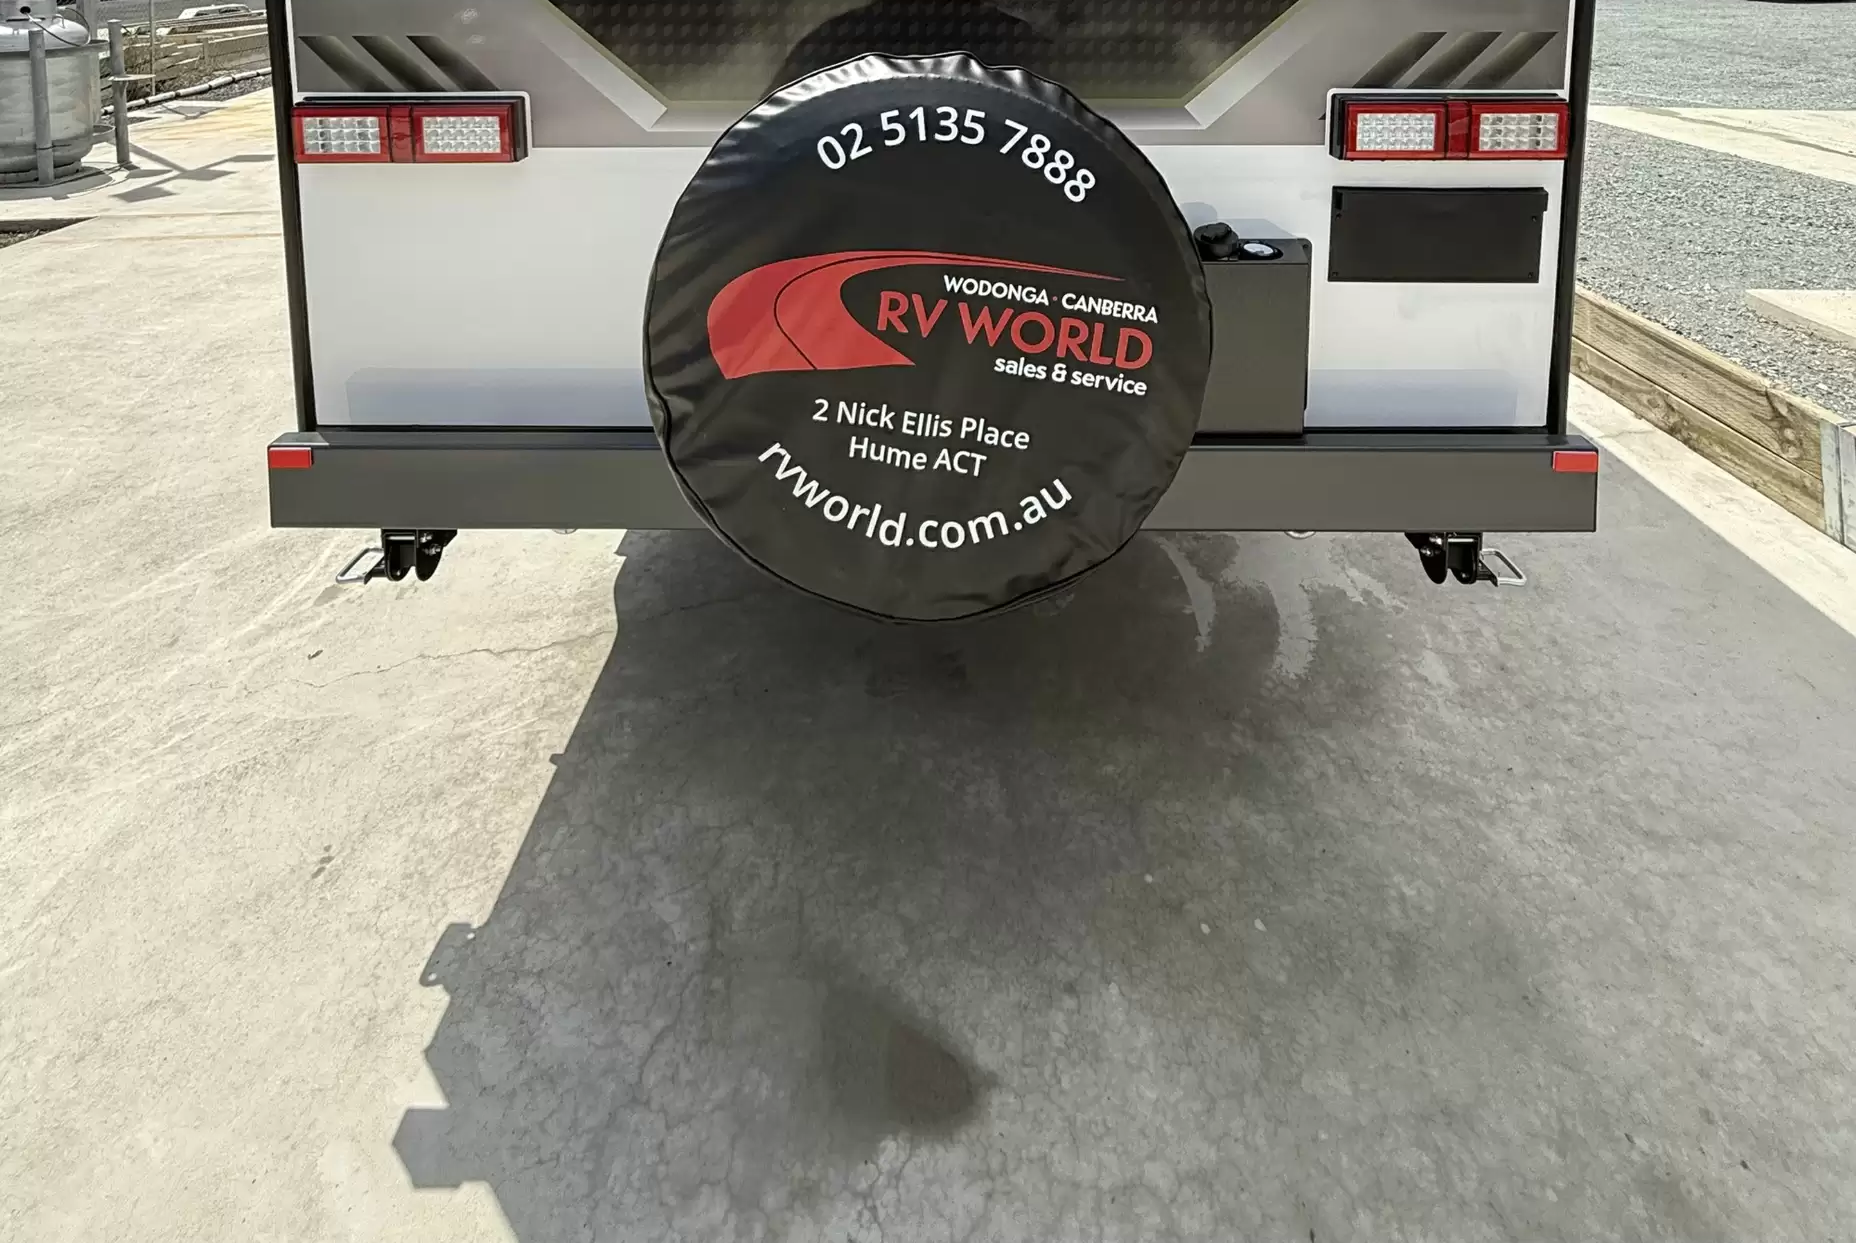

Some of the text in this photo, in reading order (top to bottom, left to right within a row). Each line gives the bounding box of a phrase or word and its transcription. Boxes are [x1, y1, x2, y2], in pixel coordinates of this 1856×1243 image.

[816, 106, 1096, 203] 02 5135 7888
[943, 274, 1159, 324] WODONGA CANBERRA
[876, 290, 1154, 371] RV WORLD
[993, 355, 1148, 397] sales & service
[811, 398, 1031, 451] 2 Nick Ellis Place
[848, 436, 987, 478] Hume ACT
[758, 439, 1073, 549] rvworld.com.au
